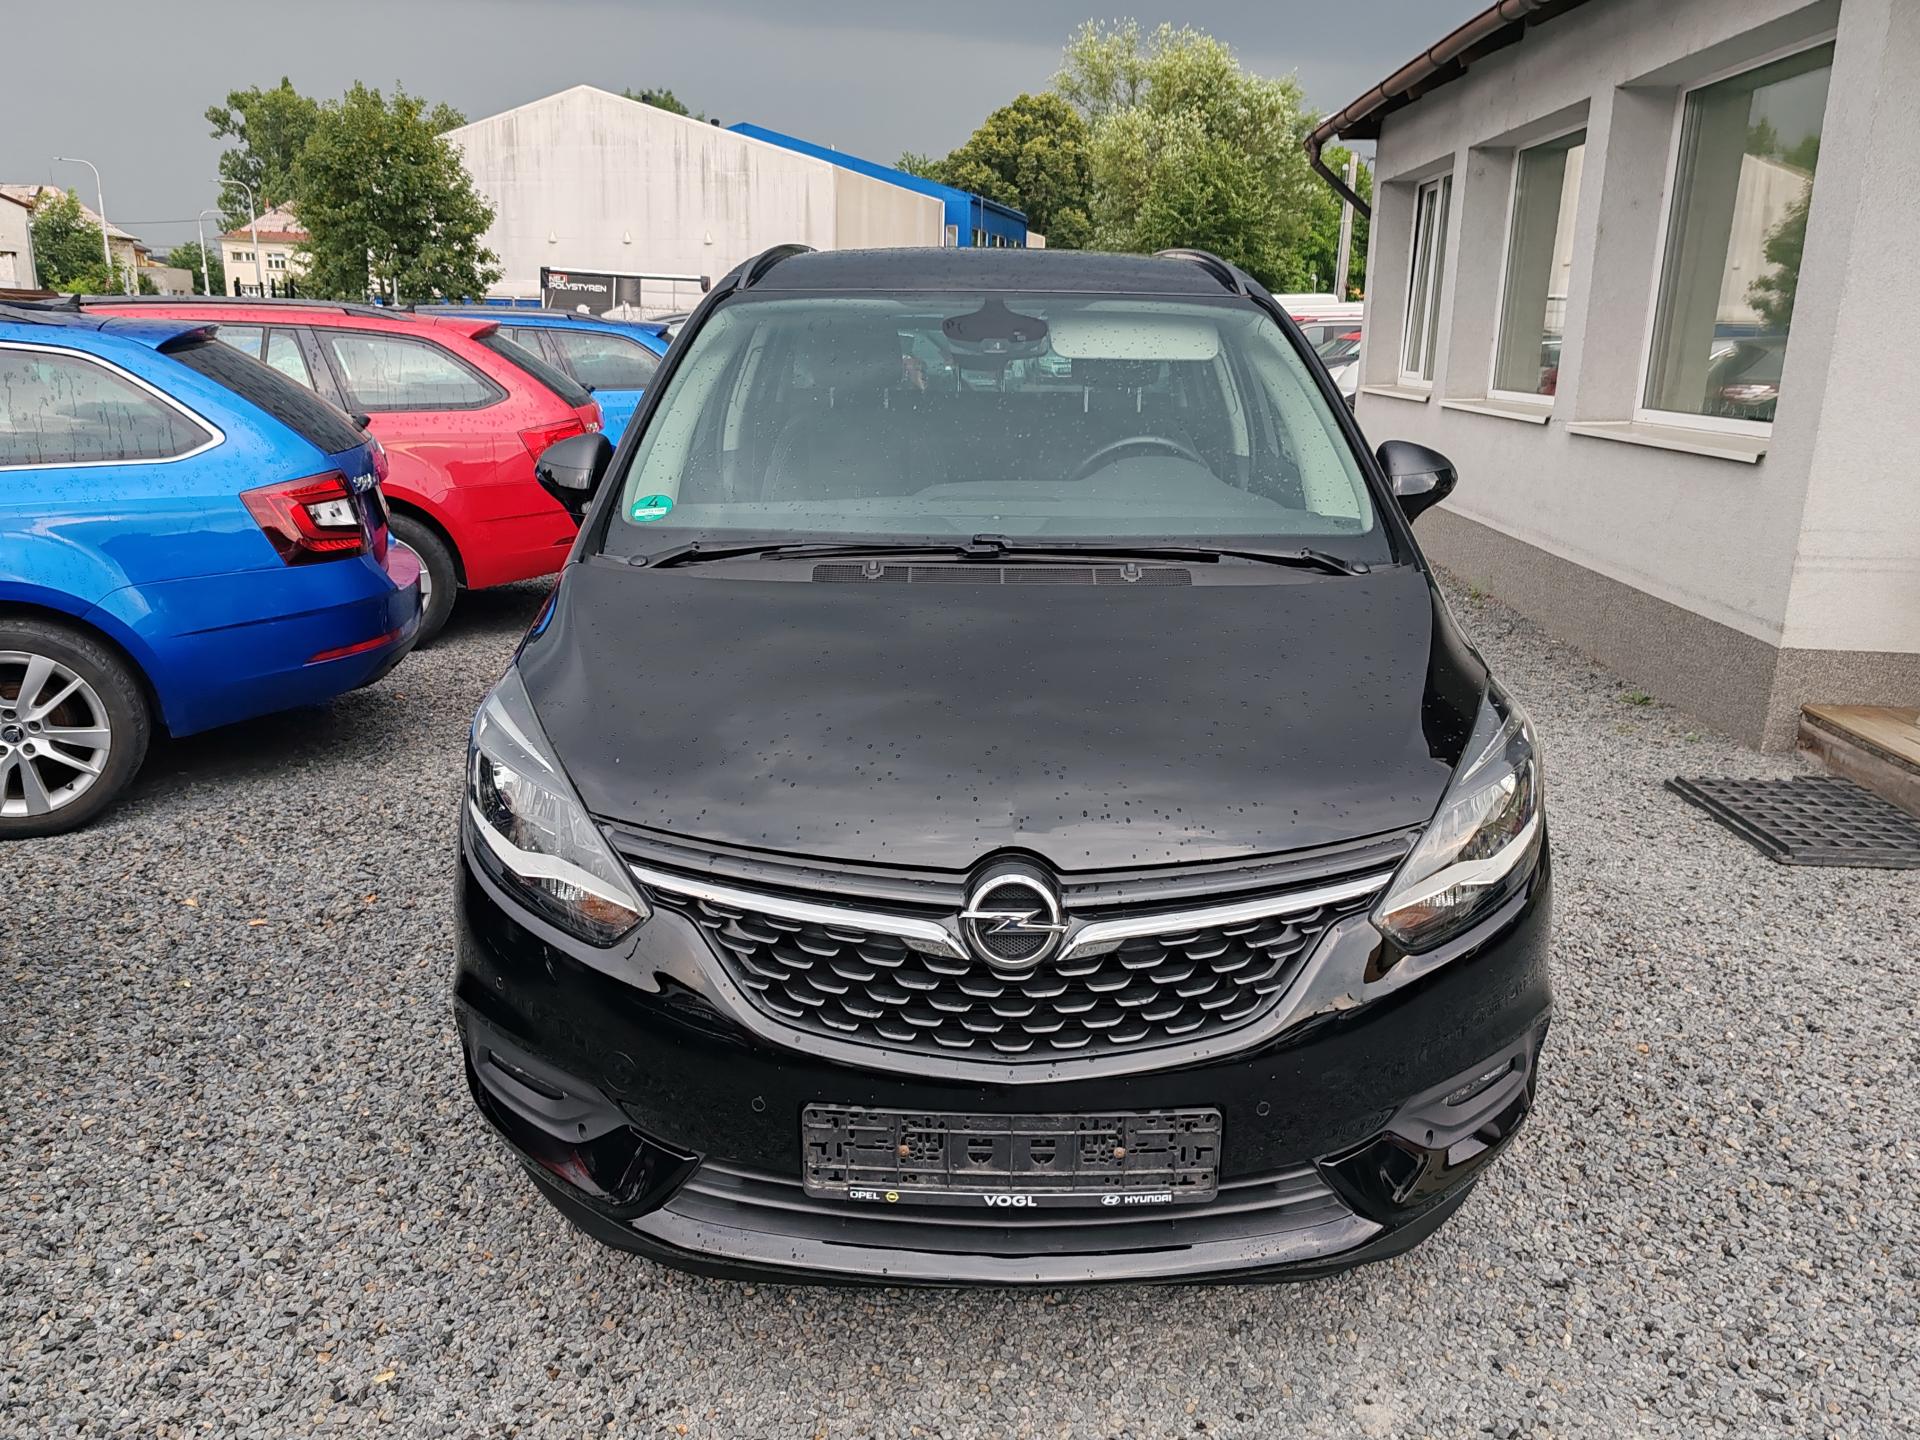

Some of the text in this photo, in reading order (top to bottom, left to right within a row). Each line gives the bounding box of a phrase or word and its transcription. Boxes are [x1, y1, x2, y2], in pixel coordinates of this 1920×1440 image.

[549, 282, 607, 292] POLYSTYREN
[647, 495, 658, 507] 4
[849, 1191, 880, 1200] OPEL
[984, 1195, 1037, 1207] VOGL
[1125, 1192, 1172, 1203] HYUNDAI
